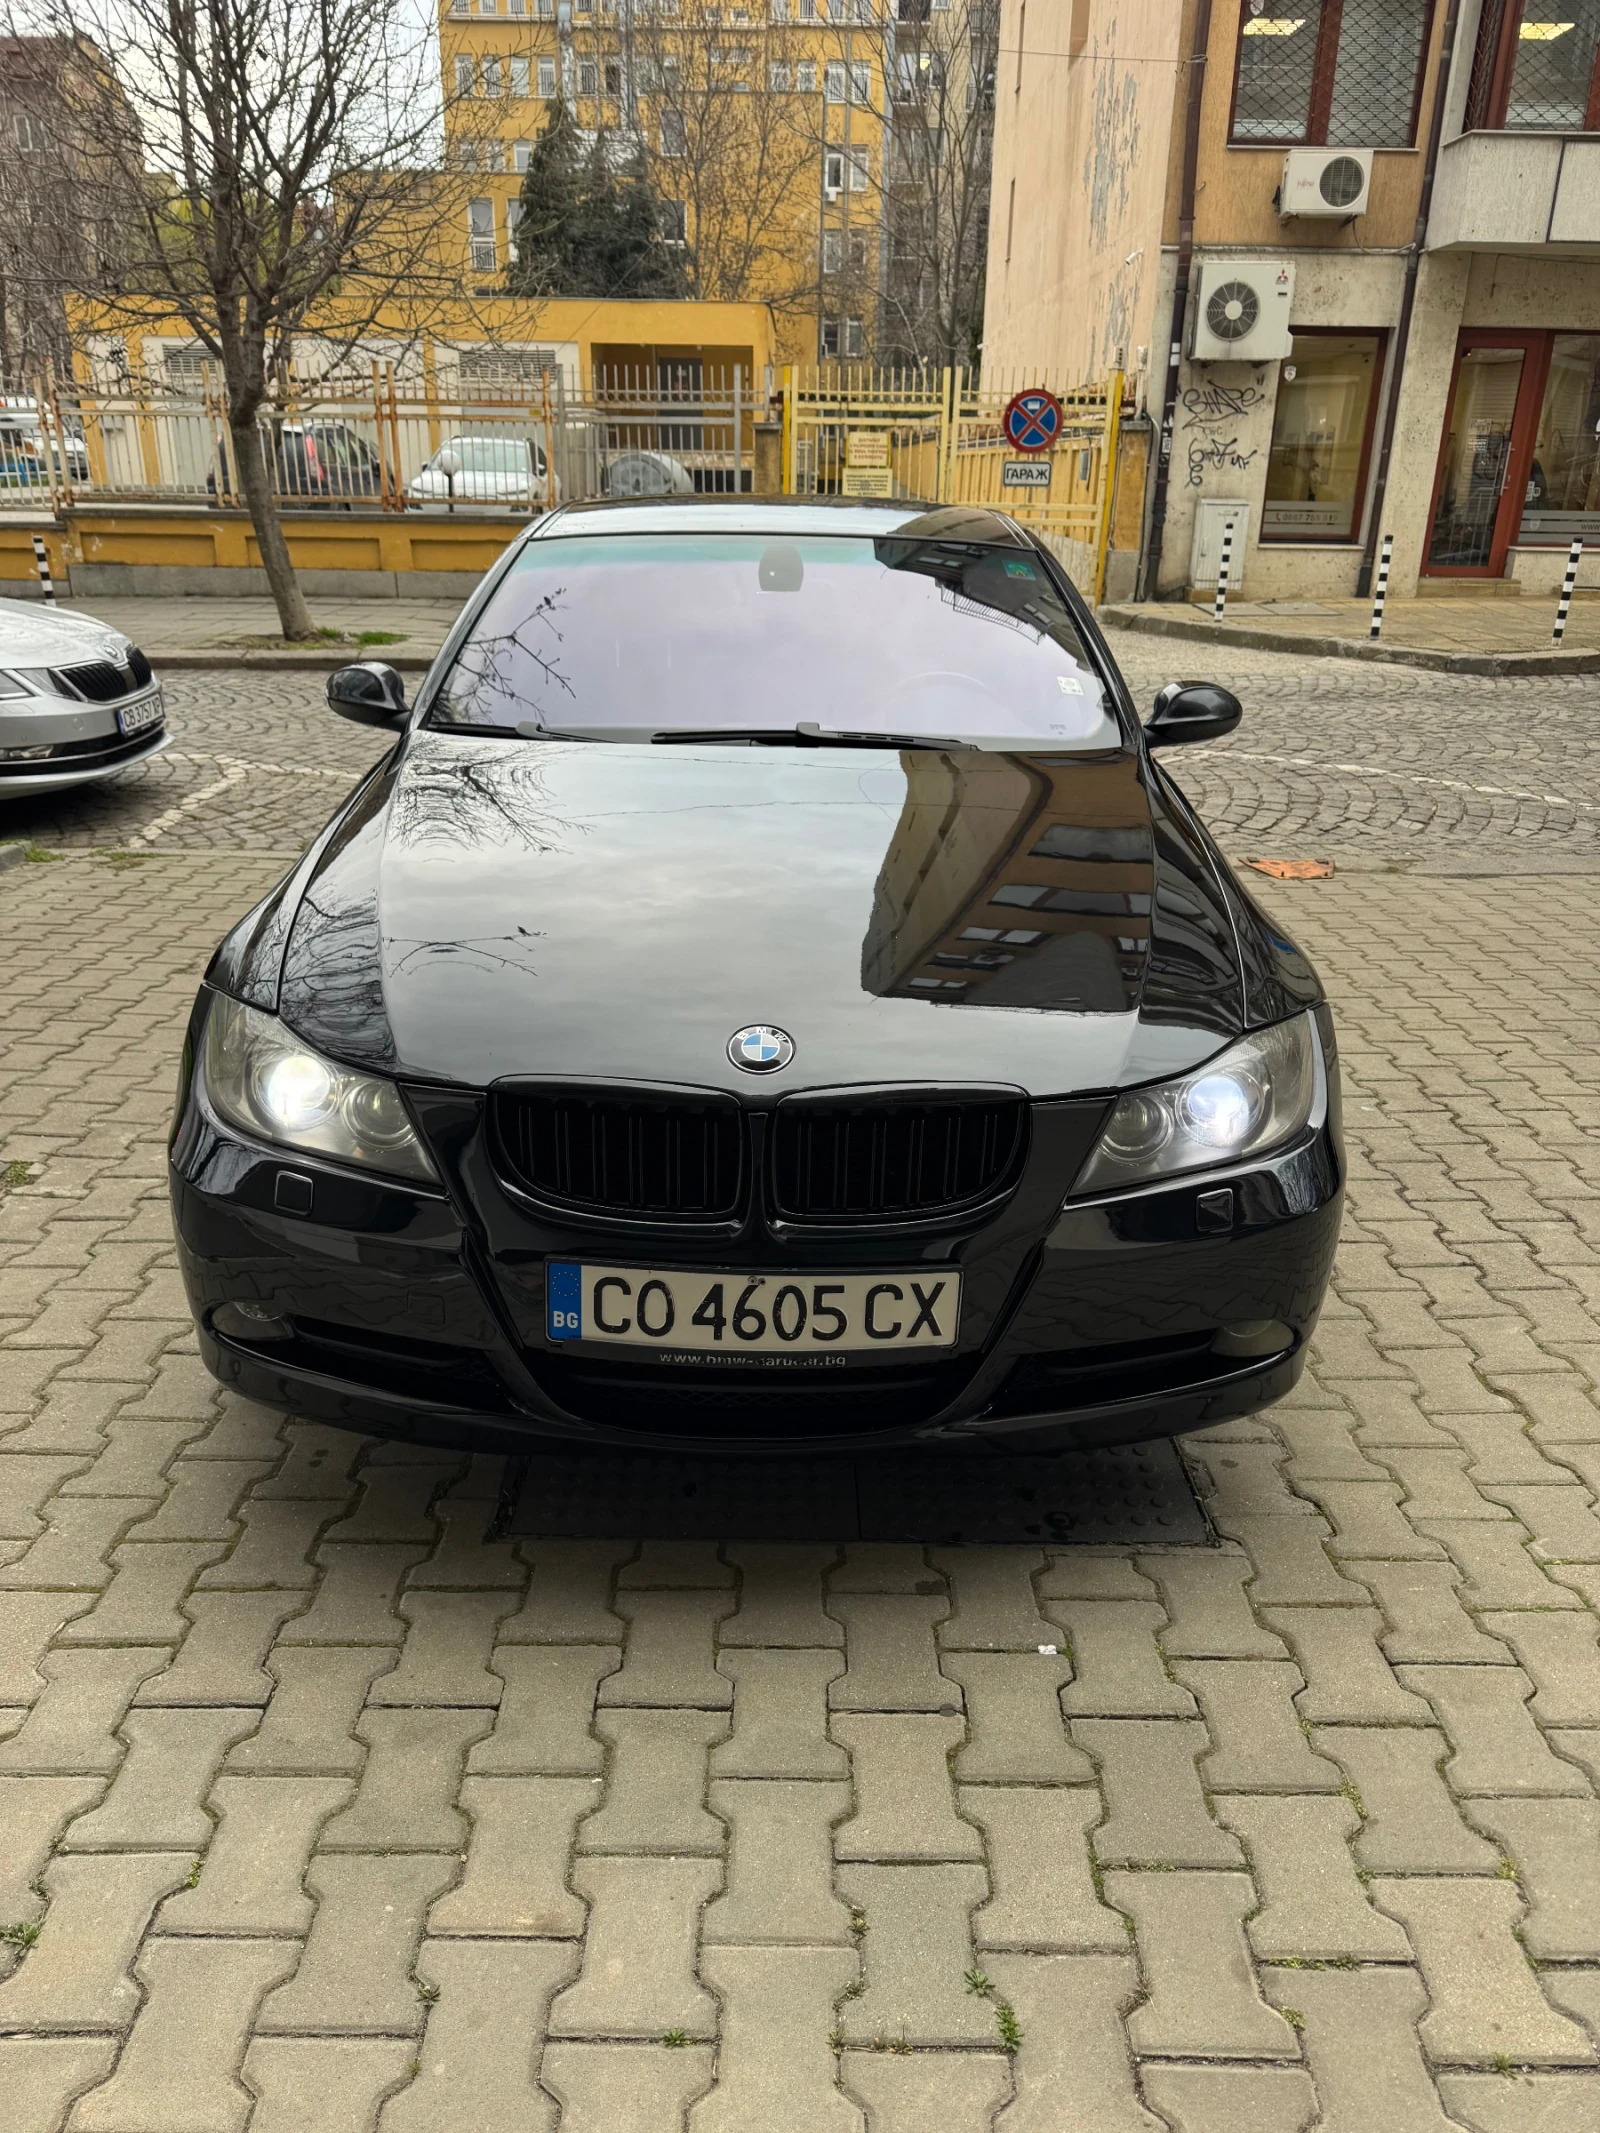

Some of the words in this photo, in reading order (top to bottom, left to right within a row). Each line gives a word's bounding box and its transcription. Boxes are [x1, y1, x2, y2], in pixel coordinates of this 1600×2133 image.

[1006, 468, 1048, 480] ГАРАЖ
[737, 1027, 788, 1042] BMW
[593, 1276, 675, 1338] CO
[691, 1283, 848, 1342] 4605
[864, 1281, 947, 1340] CX
[553, 1310, 579, 1329] BG
